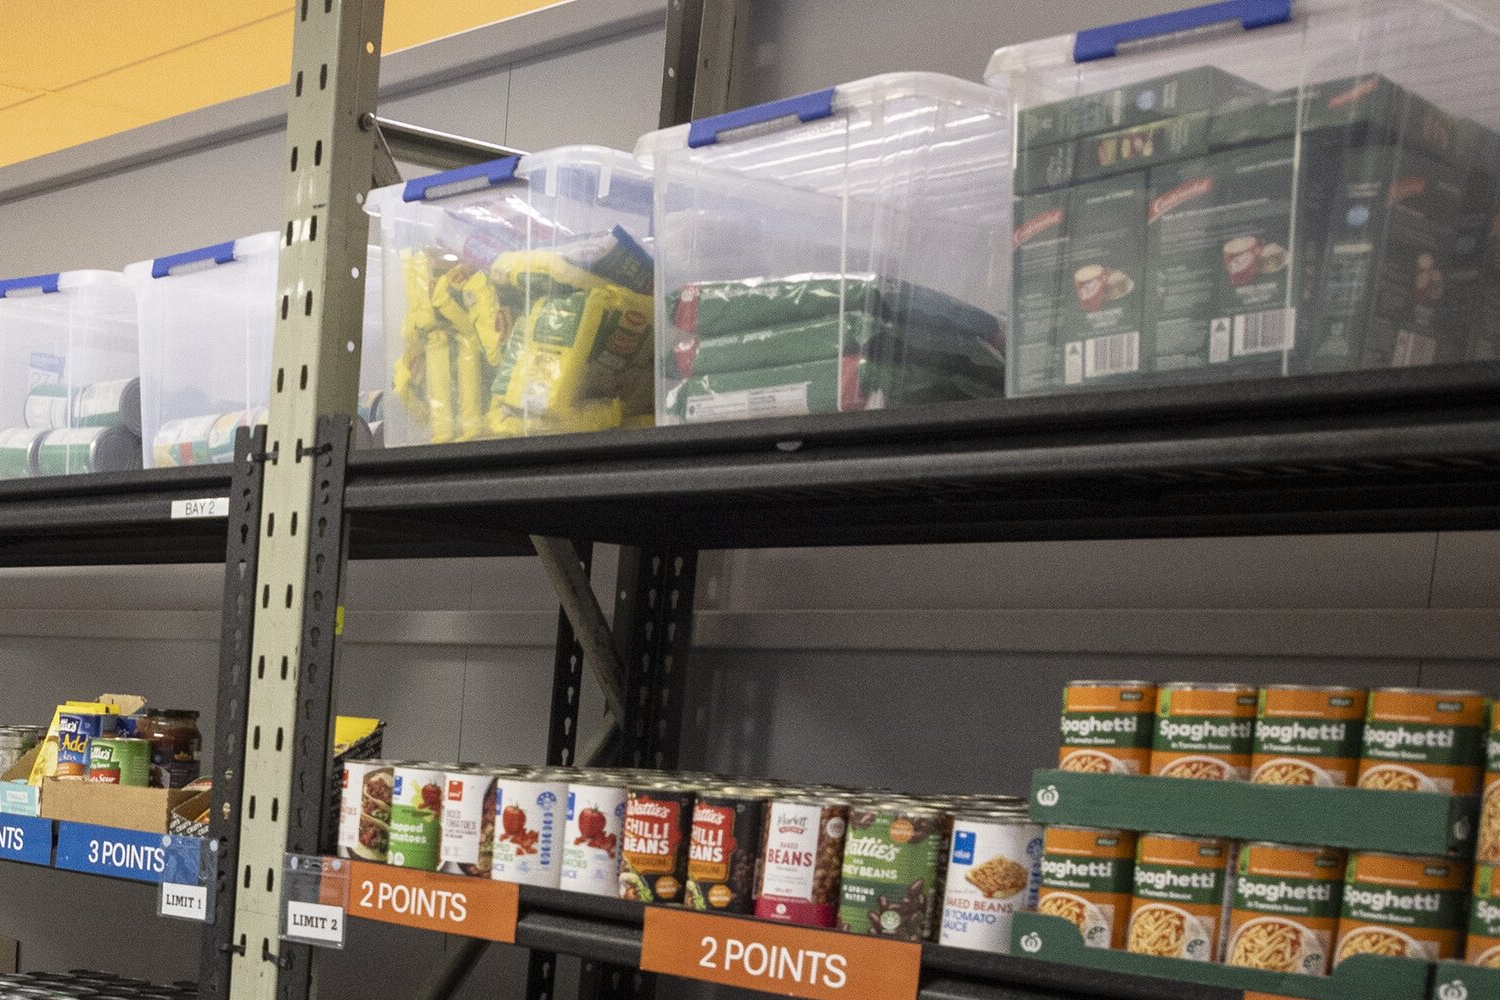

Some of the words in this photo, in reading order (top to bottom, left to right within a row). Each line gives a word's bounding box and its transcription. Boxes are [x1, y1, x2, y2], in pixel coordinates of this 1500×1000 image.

[186, 502, 205, 515] BAY
[209, 502, 215, 514] 2
[1160, 720, 1250, 740] Spaghetti
[1256, 721, 1345, 741] Spaghetti
[88, 841, 99, 863] 3
[102, 843, 165, 872] POINTS
[623, 838, 669, 855] BEANS
[767, 848, 813, 867] BEANS
[1238, 878, 1330, 901] Spaghetti
[1344, 886, 1440, 911] Spaghetti
[166, 893, 194, 909] LIMIT
[198, 899, 201, 910] 1
[360, 880, 374, 908] 2
[378, 882, 467, 922] POINTS
[293, 914, 327, 928] LIMIT
[331, 919, 337, 930] 2
[699, 936, 717, 969] 2
[724, 939, 848, 990] POINTS
